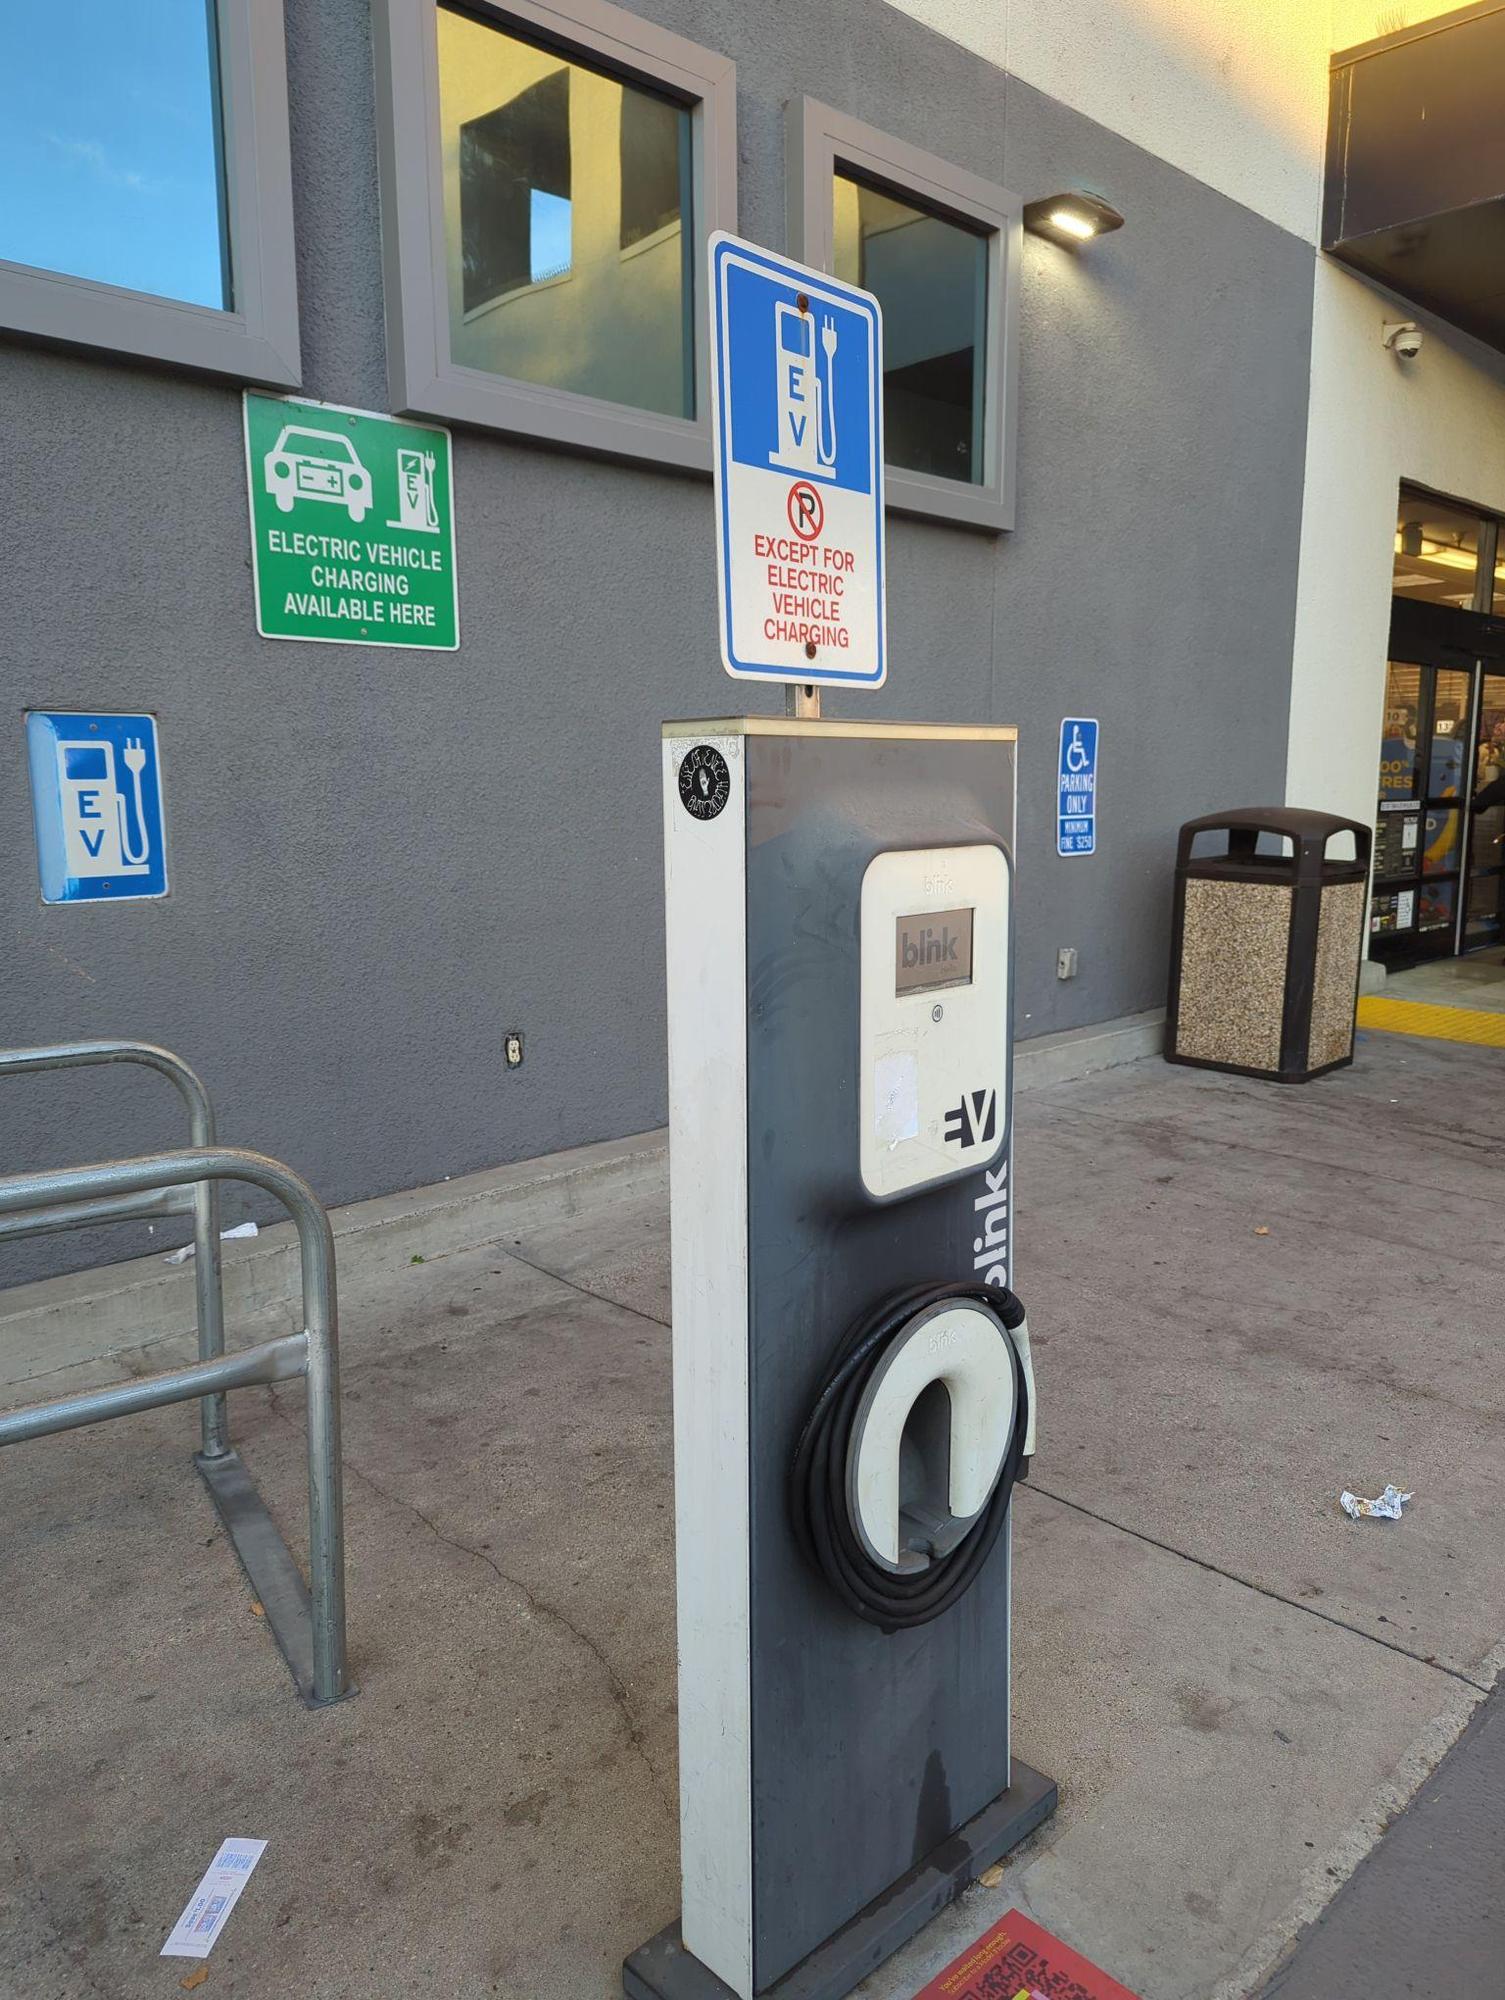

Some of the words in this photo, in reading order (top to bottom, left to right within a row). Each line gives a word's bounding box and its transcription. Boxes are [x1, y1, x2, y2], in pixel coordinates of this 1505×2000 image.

[788, 364, 806, 448] EV
[407, 474, 419, 510] EV
[268, 529, 361, 562] ELECTRIC
[366, 541, 442, 571] VEHICLE
[754, 534, 819, 566] EXCEPT
[824, 547, 855, 573] FOR
[311, 565, 409, 595] CHARGING
[768, 564, 844, 596] ELECTRIC
[284, 592, 385, 622] AVAILABLE
[390, 604, 436, 626] HERE
[772, 591, 840, 621] VEHICLE
[764, 618, 849, 648] CHARGING
[1060, 773, 1094, 792] PARKING
[1066, 795, 1088, 814] ONLY
[78, 790, 105, 857] EV
[1064, 820, 1089, 834] MINIMUM
[1061, 837, 1073, 849] FINE
[1076, 836, 1092, 849] $250
[901, 926, 959, 969] blink
